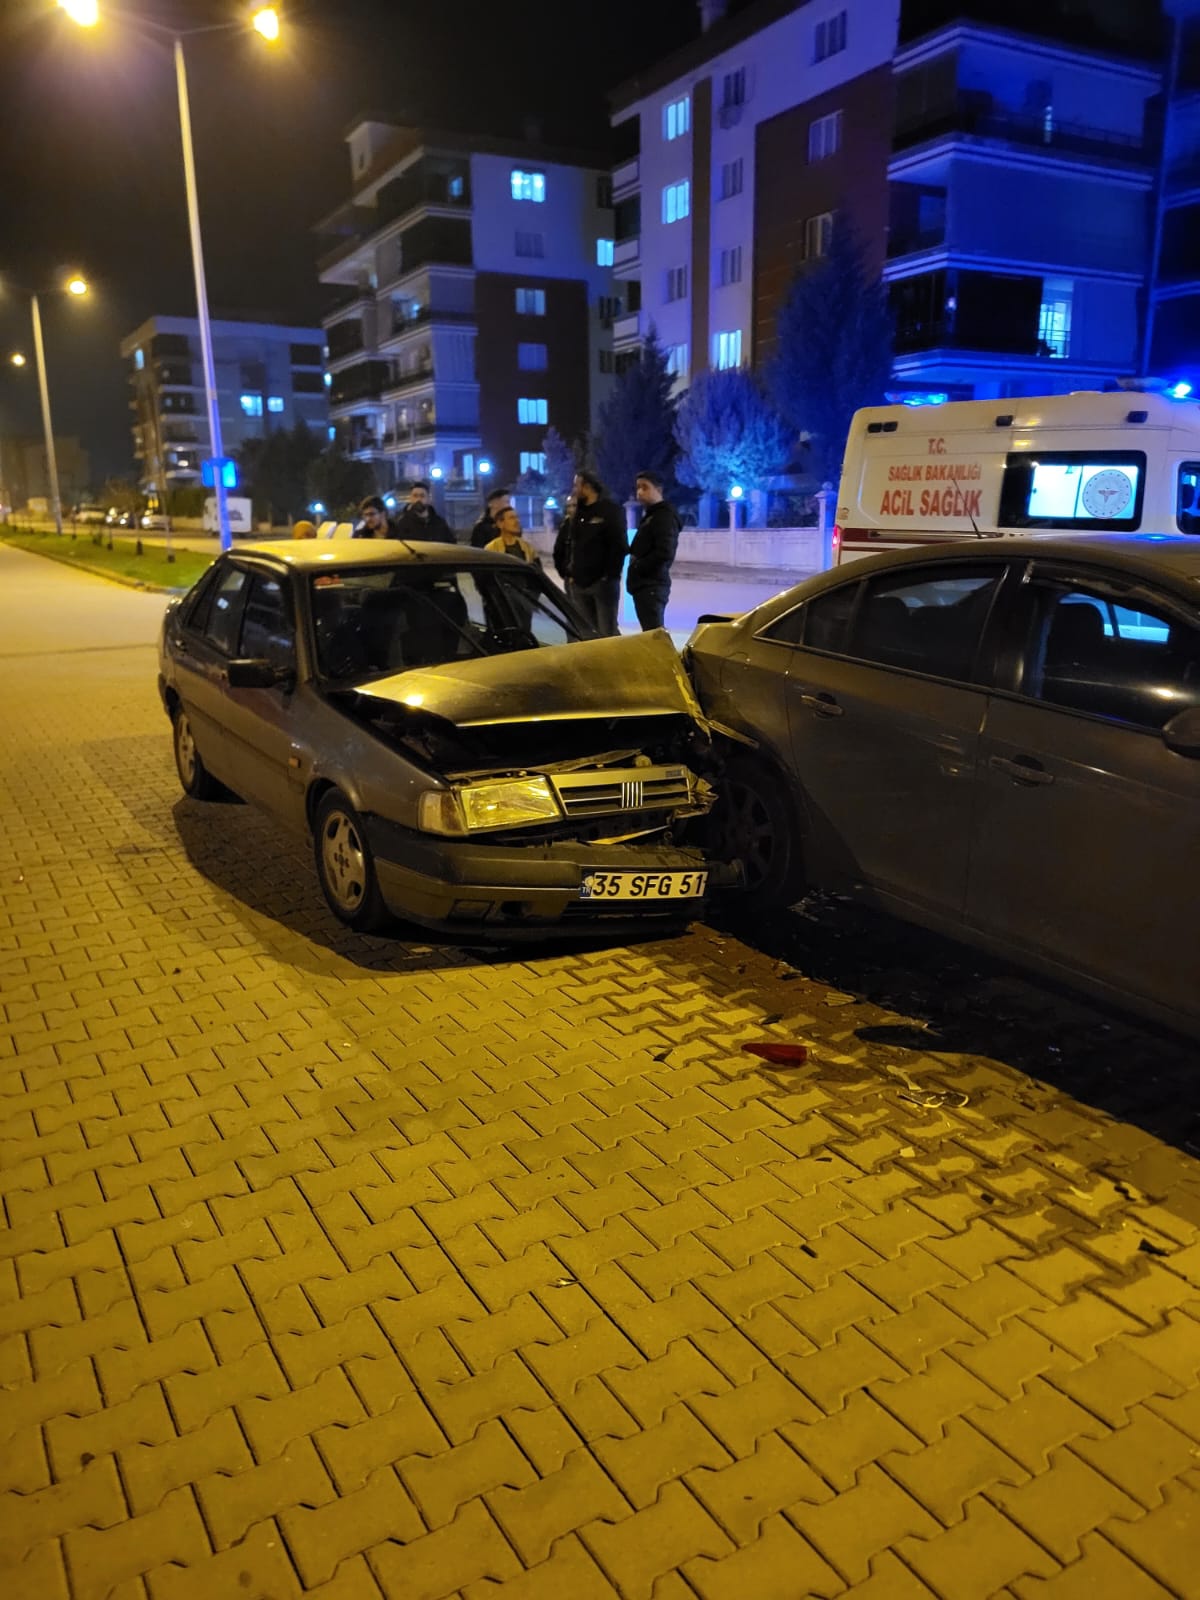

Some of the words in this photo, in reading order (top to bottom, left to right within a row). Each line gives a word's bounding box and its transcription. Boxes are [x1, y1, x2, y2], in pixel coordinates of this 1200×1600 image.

[919, 486, 983, 517] SAĞLIK
[593, 875, 622, 896] 35
[629, 875, 673, 897] SFG
[680, 874, 704, 895] 51
